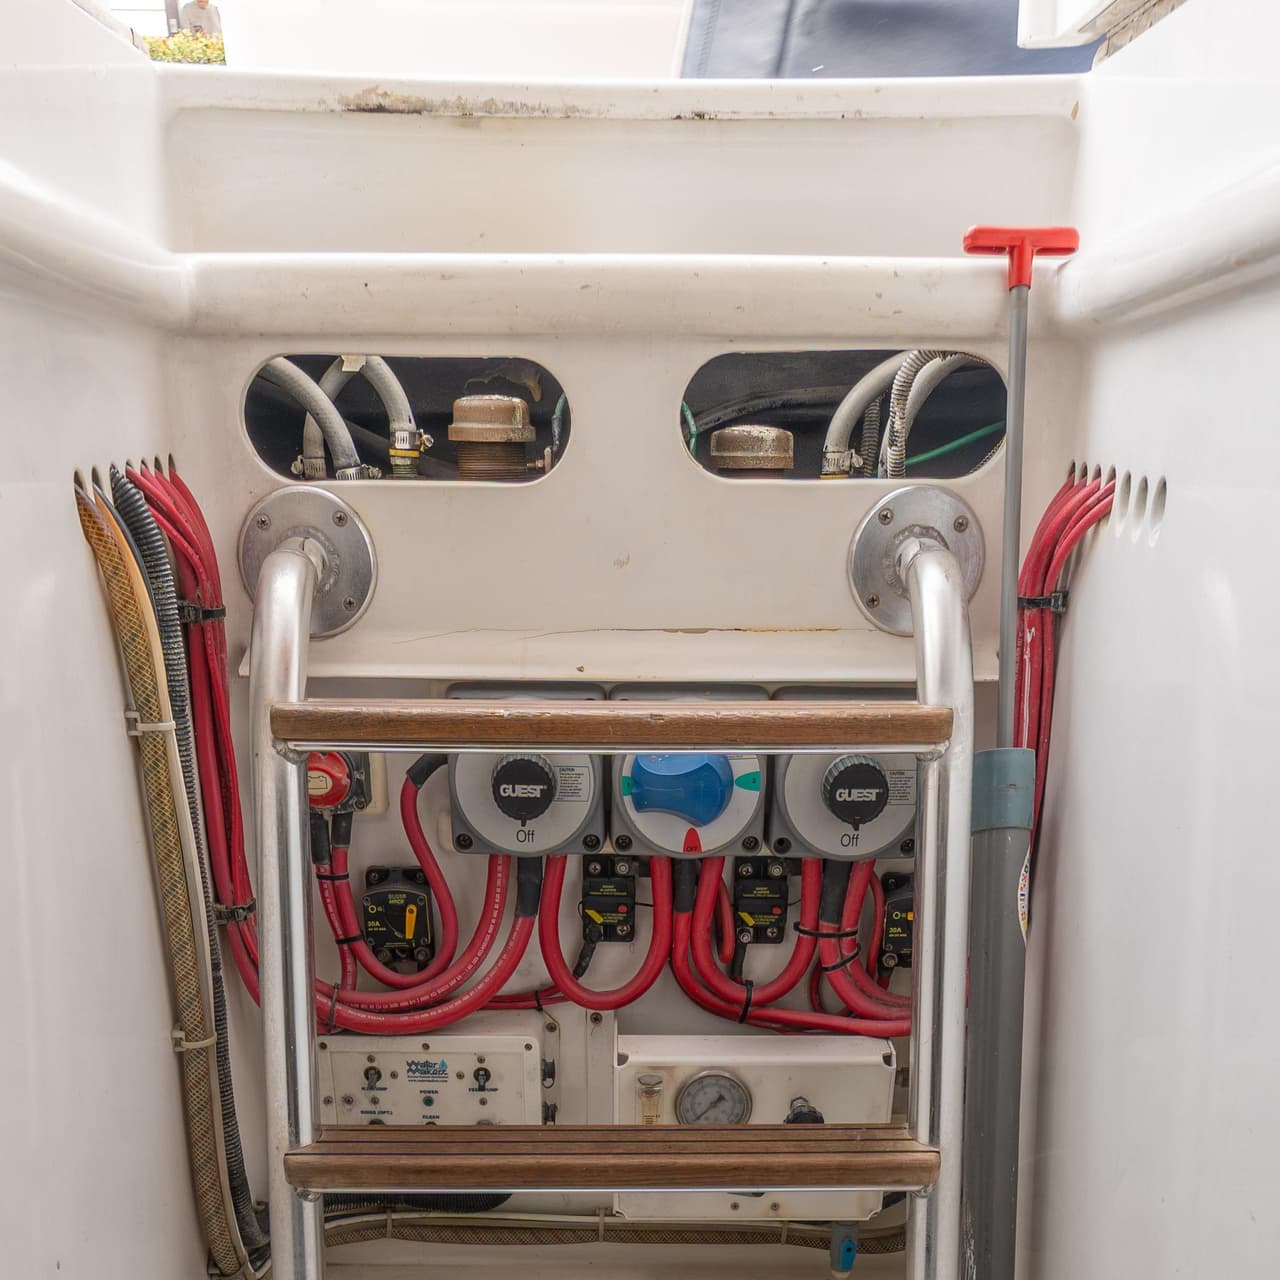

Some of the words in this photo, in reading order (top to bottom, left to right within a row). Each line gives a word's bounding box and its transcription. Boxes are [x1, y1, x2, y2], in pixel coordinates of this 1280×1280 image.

[500, 784, 543, 798] GUEST
[835, 788, 879, 801] GUEST
[516, 829, 535, 843] Off
[840, 833, 859, 848] Off
